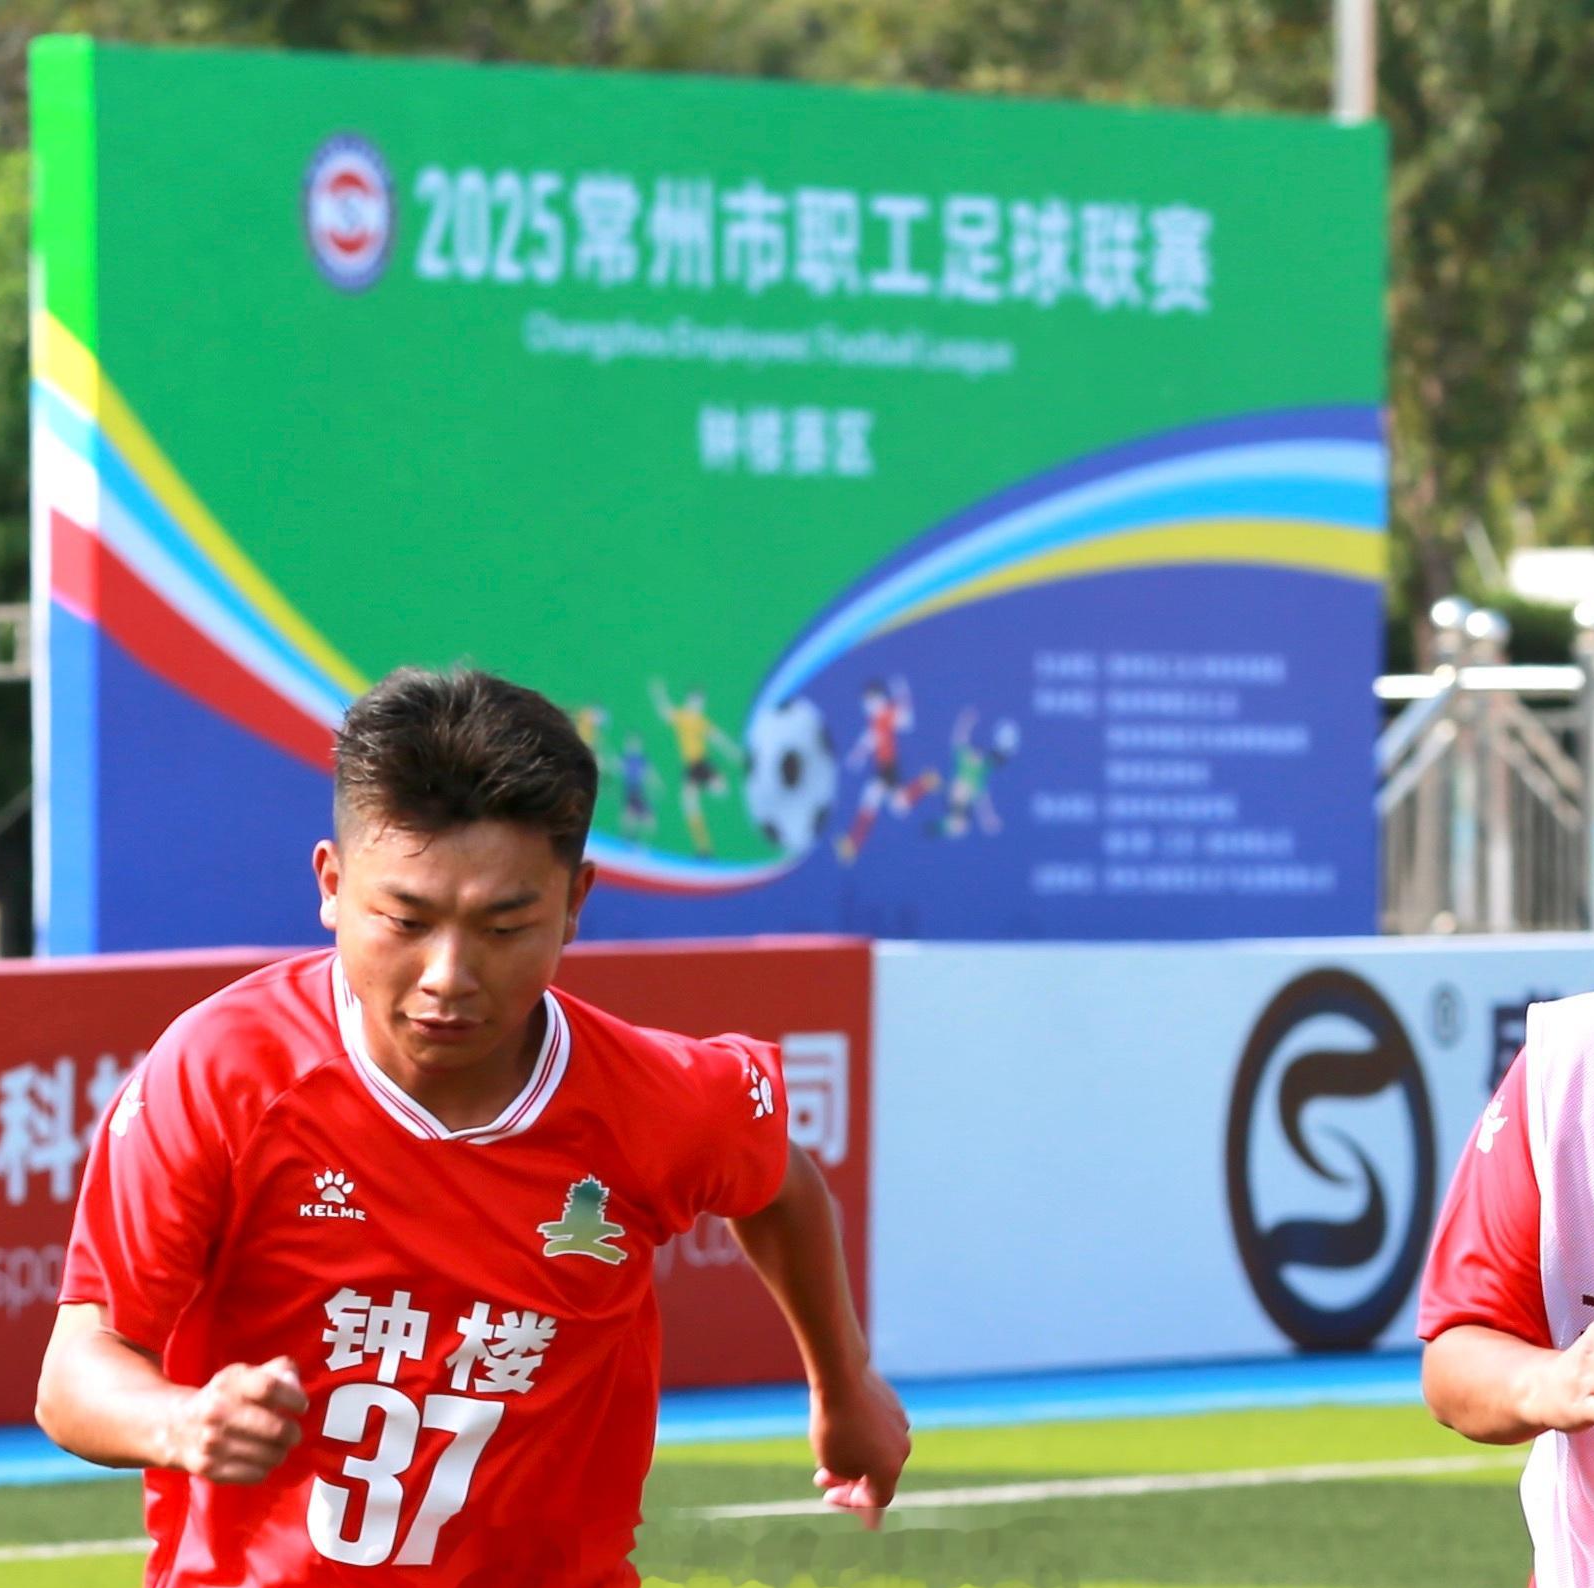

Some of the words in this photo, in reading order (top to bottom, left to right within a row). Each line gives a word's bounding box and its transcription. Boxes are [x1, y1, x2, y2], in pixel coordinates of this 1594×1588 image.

[414, 166, 1213, 312] 2025常州市职工足球联赛
[299, 1203, 367, 1222] KELME
[321, 1286, 557, 1396] 钟楼
[306, 1383, 506, 1567] 37
